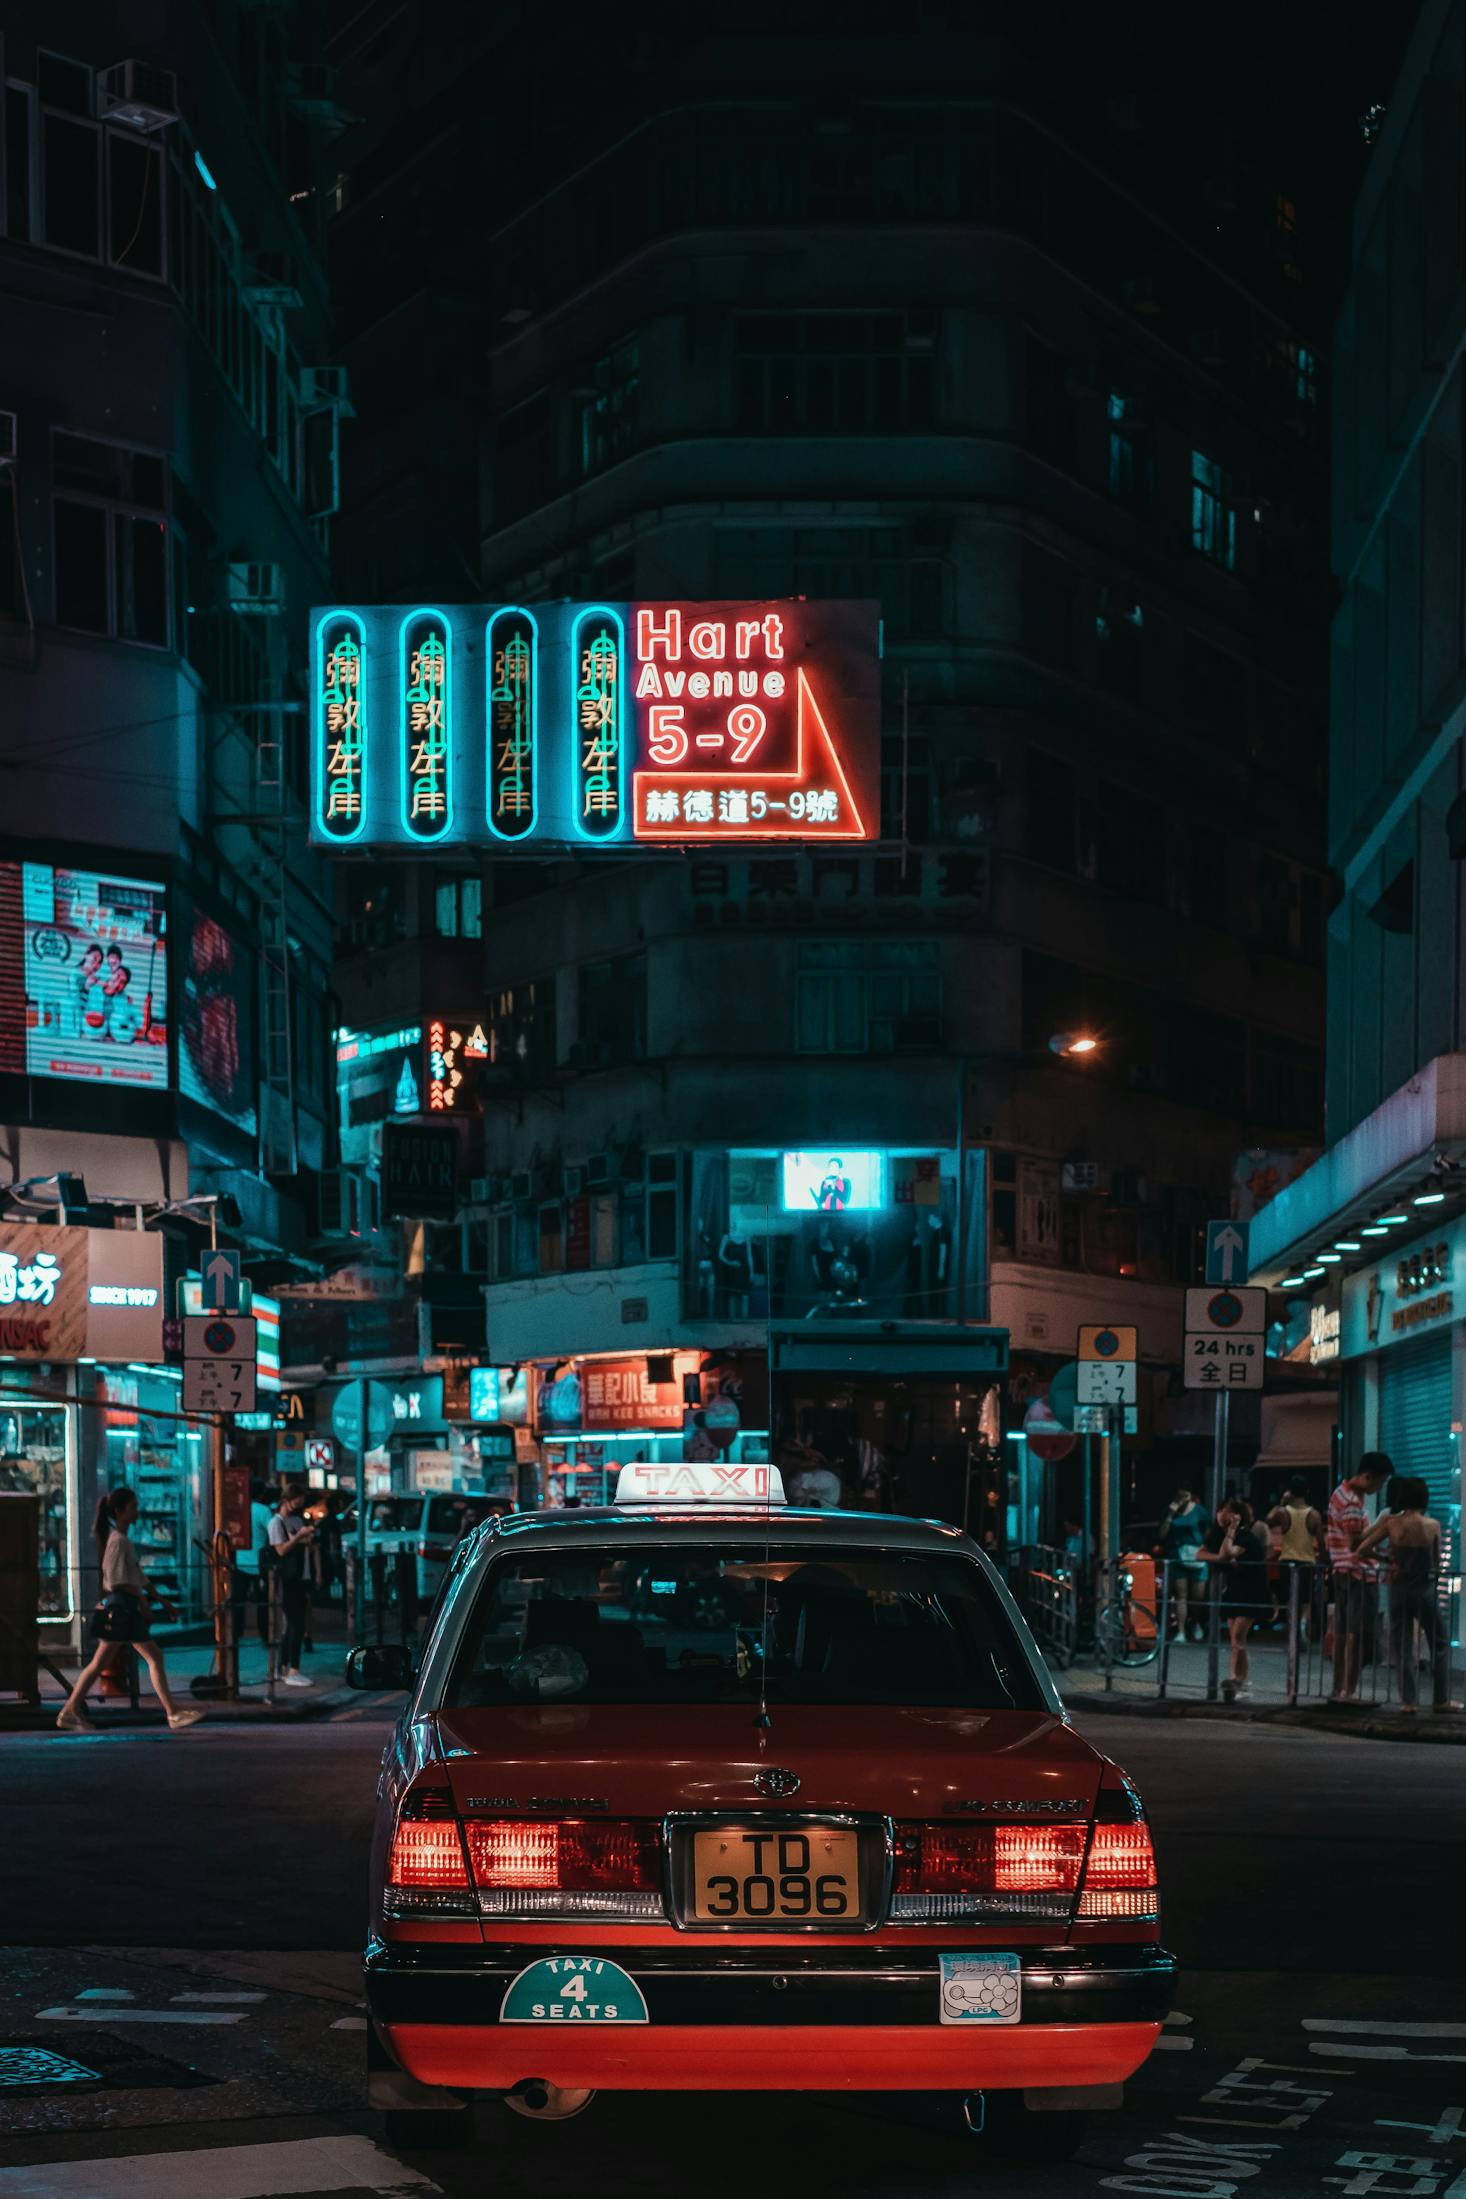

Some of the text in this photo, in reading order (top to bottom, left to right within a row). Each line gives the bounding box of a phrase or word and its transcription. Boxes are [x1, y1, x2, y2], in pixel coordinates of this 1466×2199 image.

[637, 609, 784, 661] Hart
[636, 662, 786, 698] Avenue
[648, 703, 767, 765] 5-9
[1194, 1340, 1255, 1356] 24 hrs
[230, 1364, 242, 1381] 7
[1115, 1365, 1125, 1378] 7
[1199, 1361, 1247, 1382] 全日
[230, 1391, 242, 1408] 7
[1115, 1387, 1125, 1401] 7
[636, 1404, 680, 1419] SNACKS
[634, 1467, 768, 1496] TAXI
[742, 1834, 811, 1874] TD
[707, 1875, 848, 1916] 3096
[545, 1958, 604, 1975] TAXI
[560, 1974, 588, 2002] 4
[531, 2004, 618, 2018] SEATS
[1098, 2057, 1356, 2199] OOK LEFT
